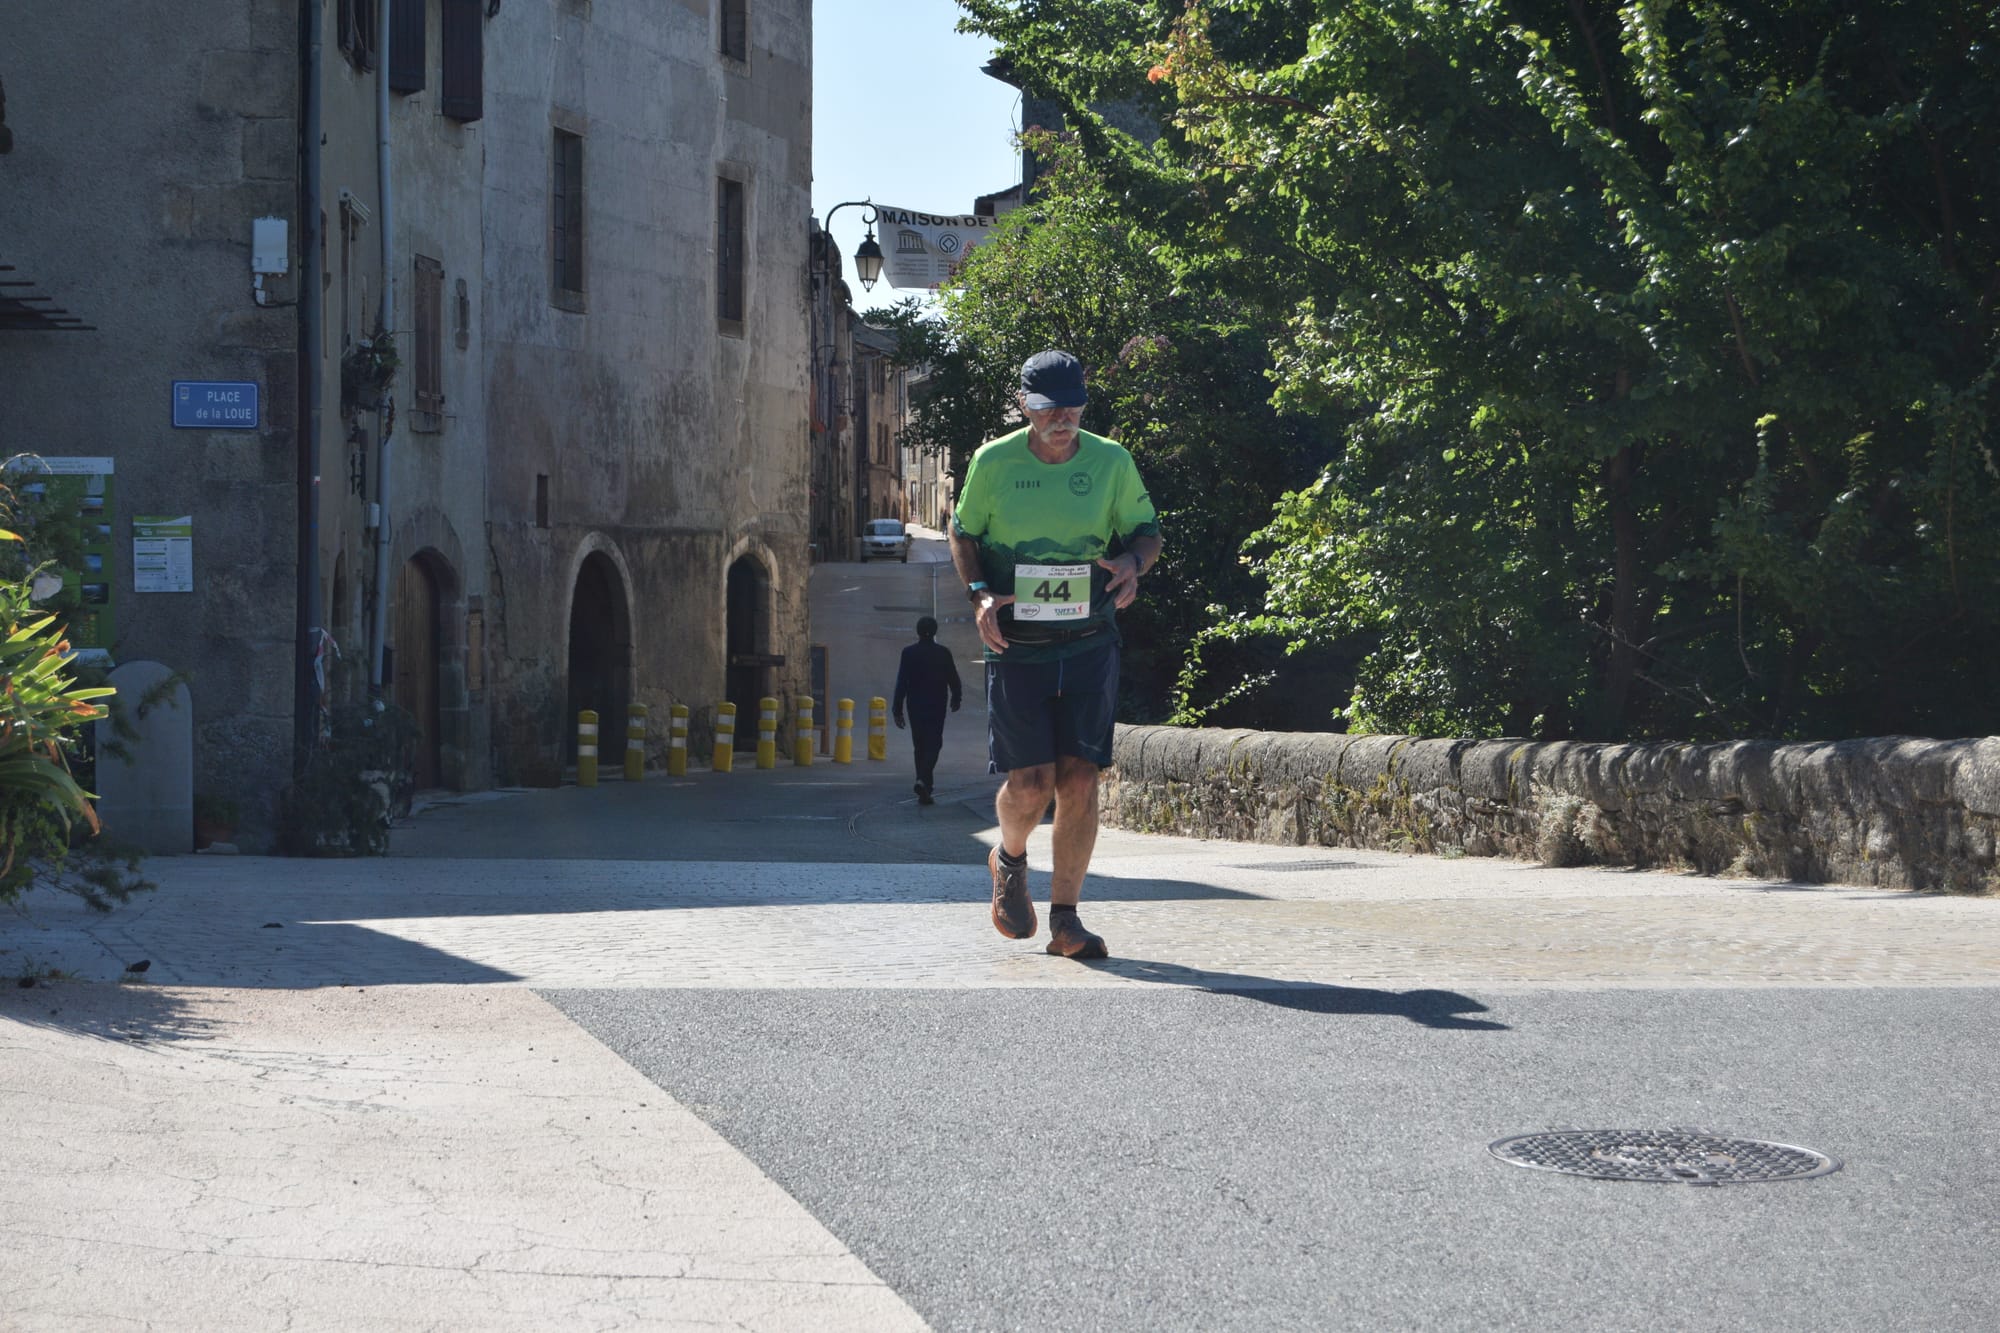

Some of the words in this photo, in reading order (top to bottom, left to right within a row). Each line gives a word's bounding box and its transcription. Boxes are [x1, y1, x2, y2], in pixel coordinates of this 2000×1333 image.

[882, 210, 958, 227] MAISON
[963, 217, 989, 227] DE
[207, 391, 241, 402] PLACE
[196, 408, 208, 419] de
[212, 408, 221, 419] la
[224, 408, 252, 420] LOUE
[1033, 580, 1071, 602] 44
